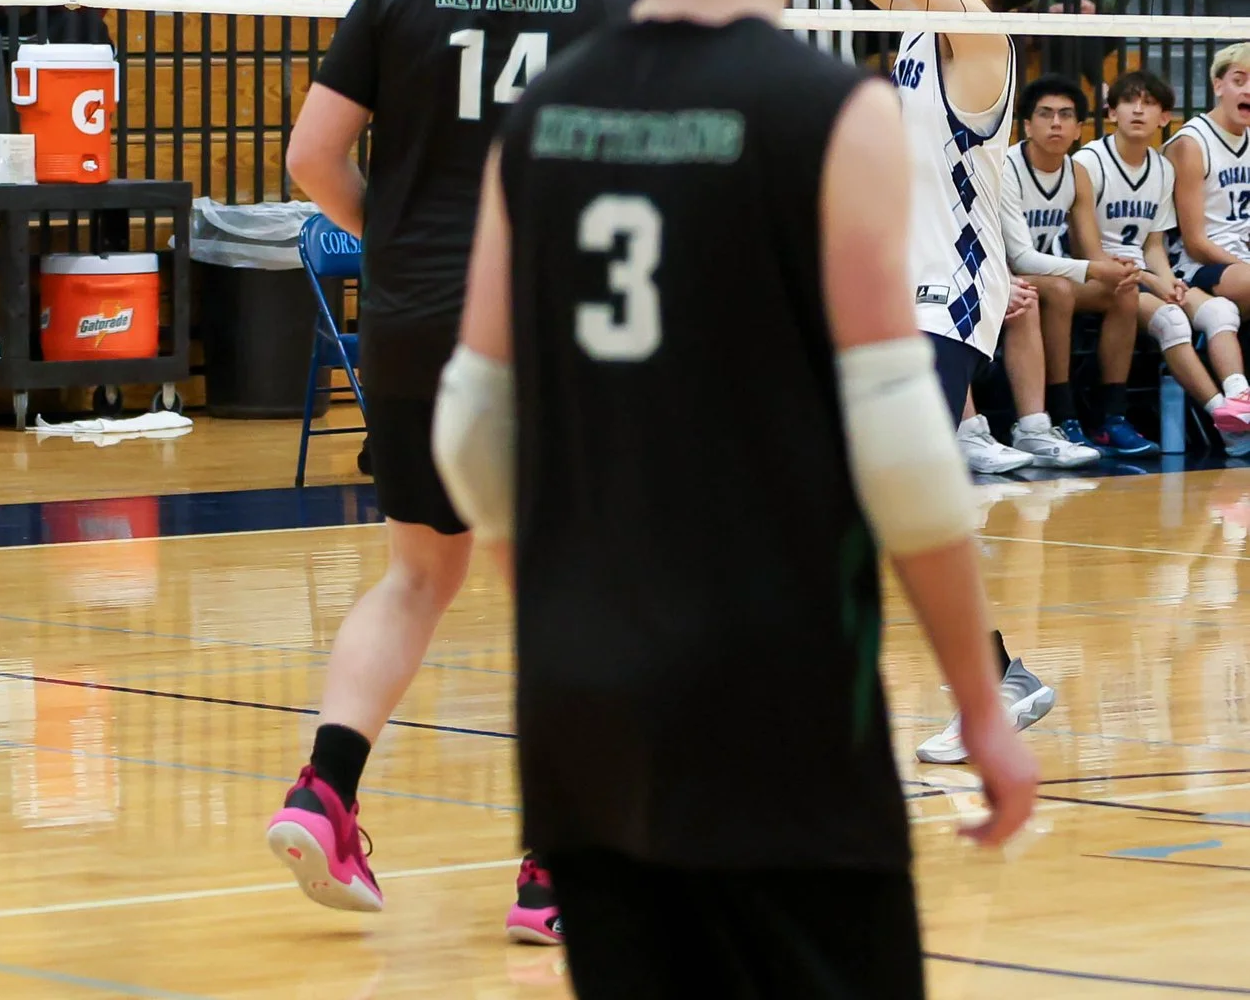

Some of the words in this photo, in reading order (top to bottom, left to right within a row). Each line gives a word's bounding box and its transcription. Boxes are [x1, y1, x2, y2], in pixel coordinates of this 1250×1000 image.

[449, 27, 549, 120] 14
[71, 89, 105, 135] G
[1121, 224, 1142, 246] 2
[575, 194, 663, 363] 3
[80, 315, 128, 334] Gatorade
